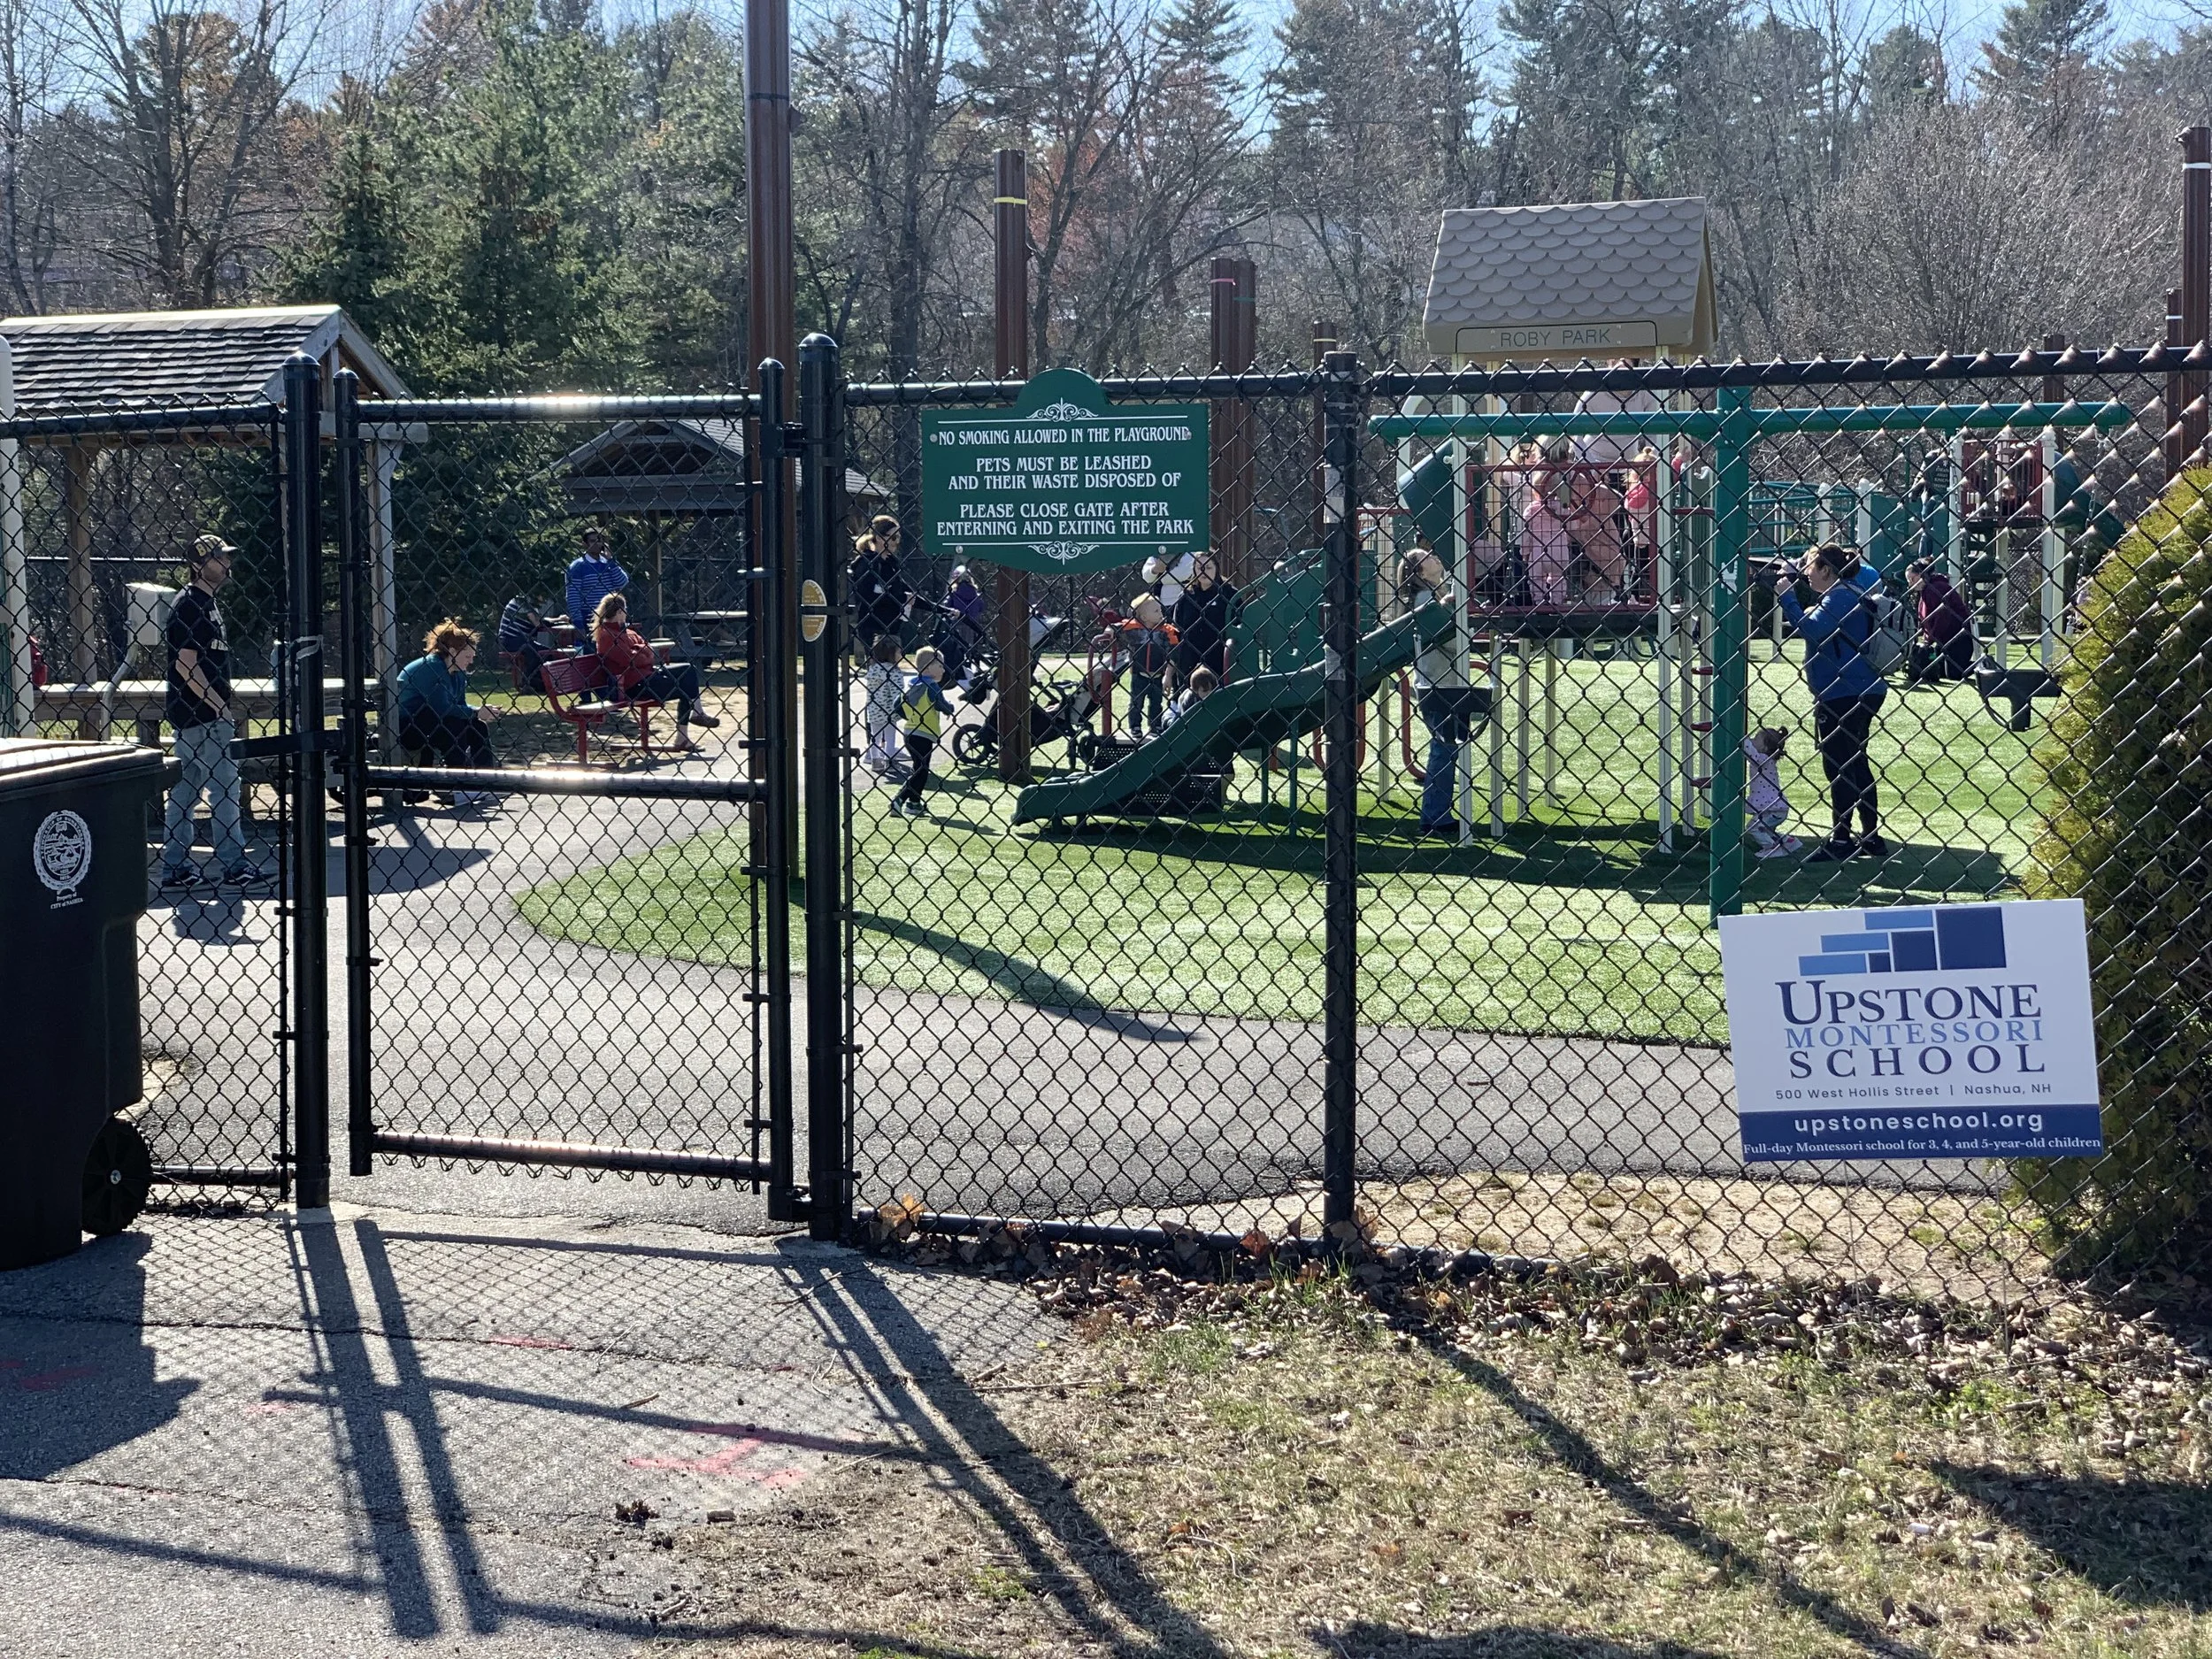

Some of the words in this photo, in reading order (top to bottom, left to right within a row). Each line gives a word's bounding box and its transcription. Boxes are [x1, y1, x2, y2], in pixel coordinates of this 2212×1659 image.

[1501, 331, 1551, 348] ROBY
[1562, 328, 1611, 345] PARK
[938, 430, 955, 446] NO
[958, 429, 1010, 445] SMOKING
[1013, 428, 1067, 444] ALLOWED
[1071, 428, 1084, 442] IN
[1087, 427, 1110, 442] THE
[1114, 426, 1190, 442] PLAYGROUND
[976, 457, 1010, 472] PETS
[1017, 457, 1055, 472] MUST
[1060, 457, 1079, 472] BE
[1084, 455, 1151, 471] LEASHED
[949, 475, 979, 490] AND
[983, 475, 1026, 490] THEIR
[1033, 474, 1079, 489] WASTE
[1085, 472, 1156, 488] DISPOSED
[1161, 472, 1181, 488] OF
[960, 503, 1015, 518] PLEASE
[1020, 503, 1069, 518] CLOSE
[1074, 503, 1114, 517] GATE
[1120, 502, 1170, 517] AFTER
[937, 521, 1018, 536] ENTERNING
[1023, 520, 1053, 536] AND
[1058, 519, 1116, 535] EXITING
[1121, 519, 1150, 534] THE
[1156, 518, 1194, 534] PARK
[1785, 1019, 2044, 1048] MONTESSORI
[1790, 1043, 2046, 1079] SCHOOL
[1775, 1088, 1803, 1101] 500
[1808, 1087, 1844, 1099] West
[1848, 1087, 1890, 1098] Hollis
[1894, 1085, 1940, 1096] Street
[1964, 1083, 2025, 1095] Nashua,
[2032, 1083, 2052, 1094] NH
[1794, 1112, 2044, 1137] upstoneschool.org
[1743, 1142, 1794, 1156] Full-day
[1796, 1141, 1863, 1153] Montessori
[1865, 1140, 1905, 1151] school
[1907, 1139, 1926, 1150] for
[1928, 1140, 1939, 1151] 3,
[1941, 1138, 1953, 1151] 4,
[1955, 1138, 1978, 1149] and
[1980, 1137, 2047, 1151] 5-year-old
[2047, 1136, 2101, 1148] children
